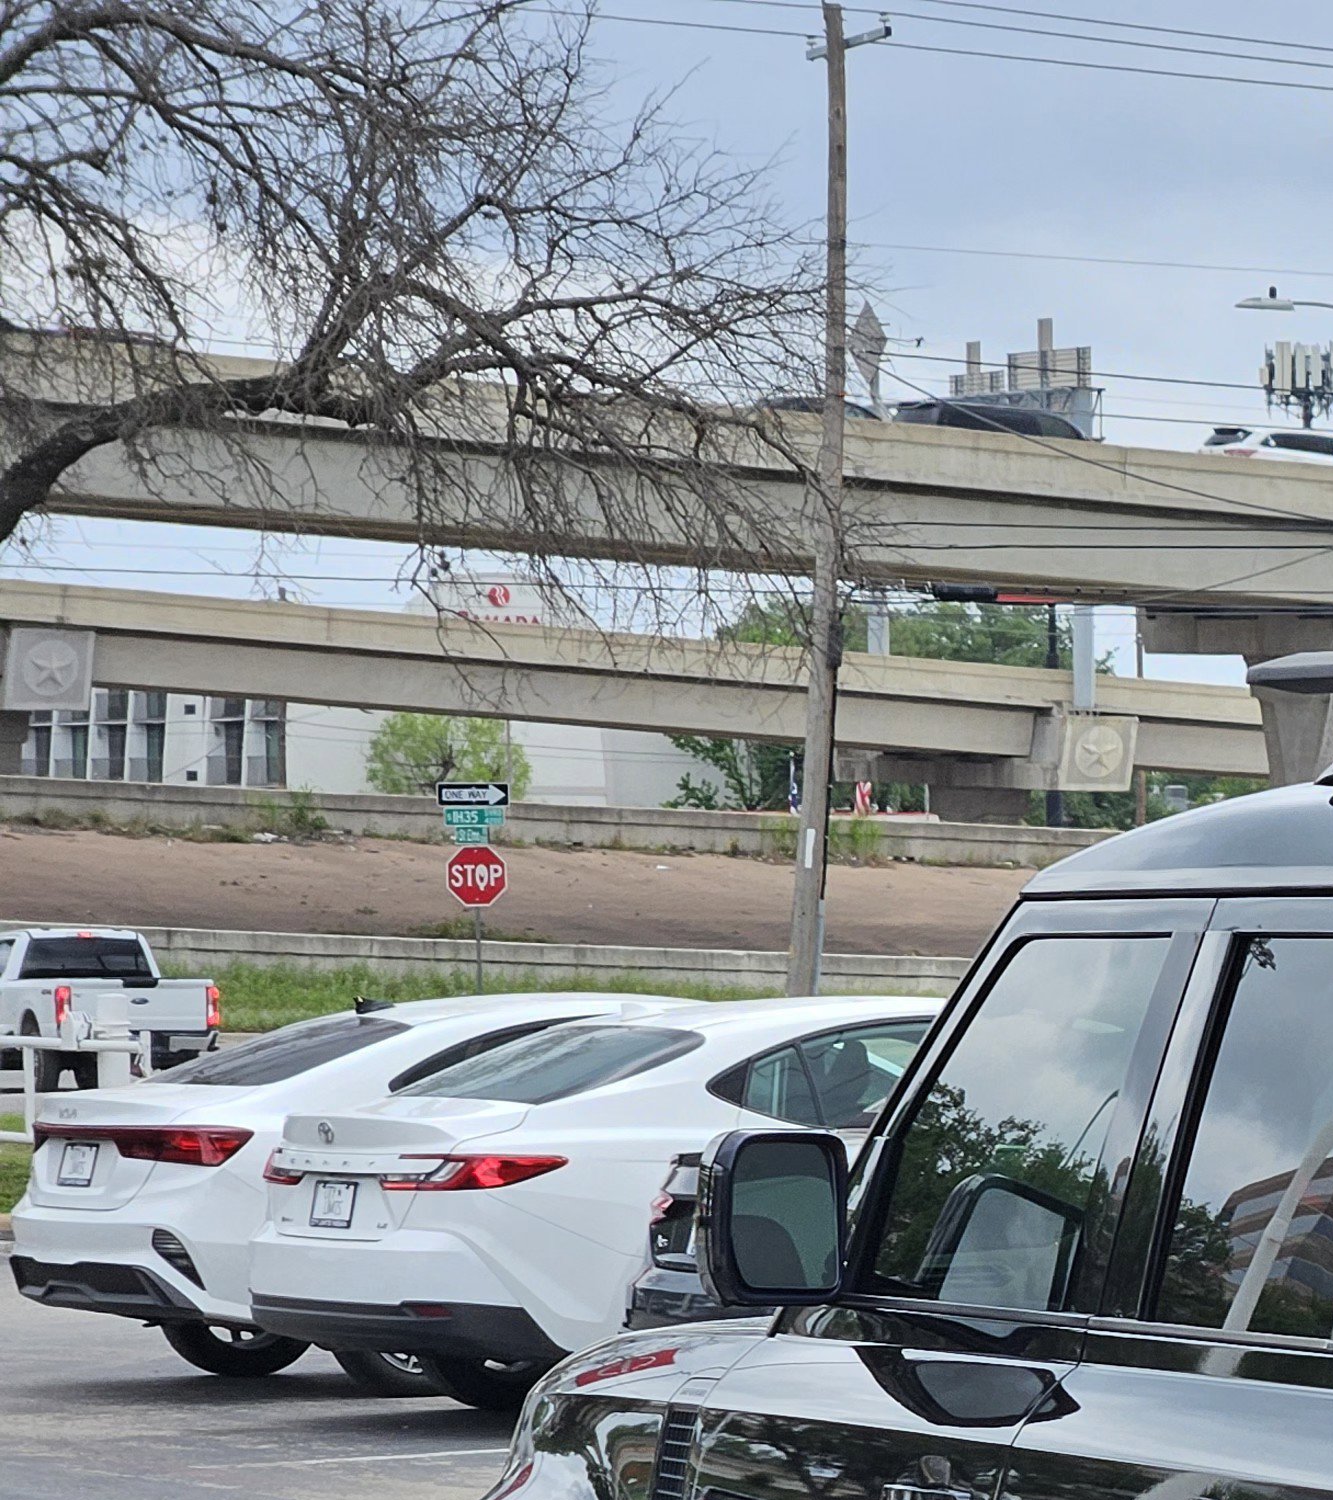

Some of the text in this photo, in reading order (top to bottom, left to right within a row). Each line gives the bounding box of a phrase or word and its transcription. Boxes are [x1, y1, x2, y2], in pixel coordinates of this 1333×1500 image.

[444, 790, 488, 800] ONE WAY
[451, 865, 503, 889] STOP
